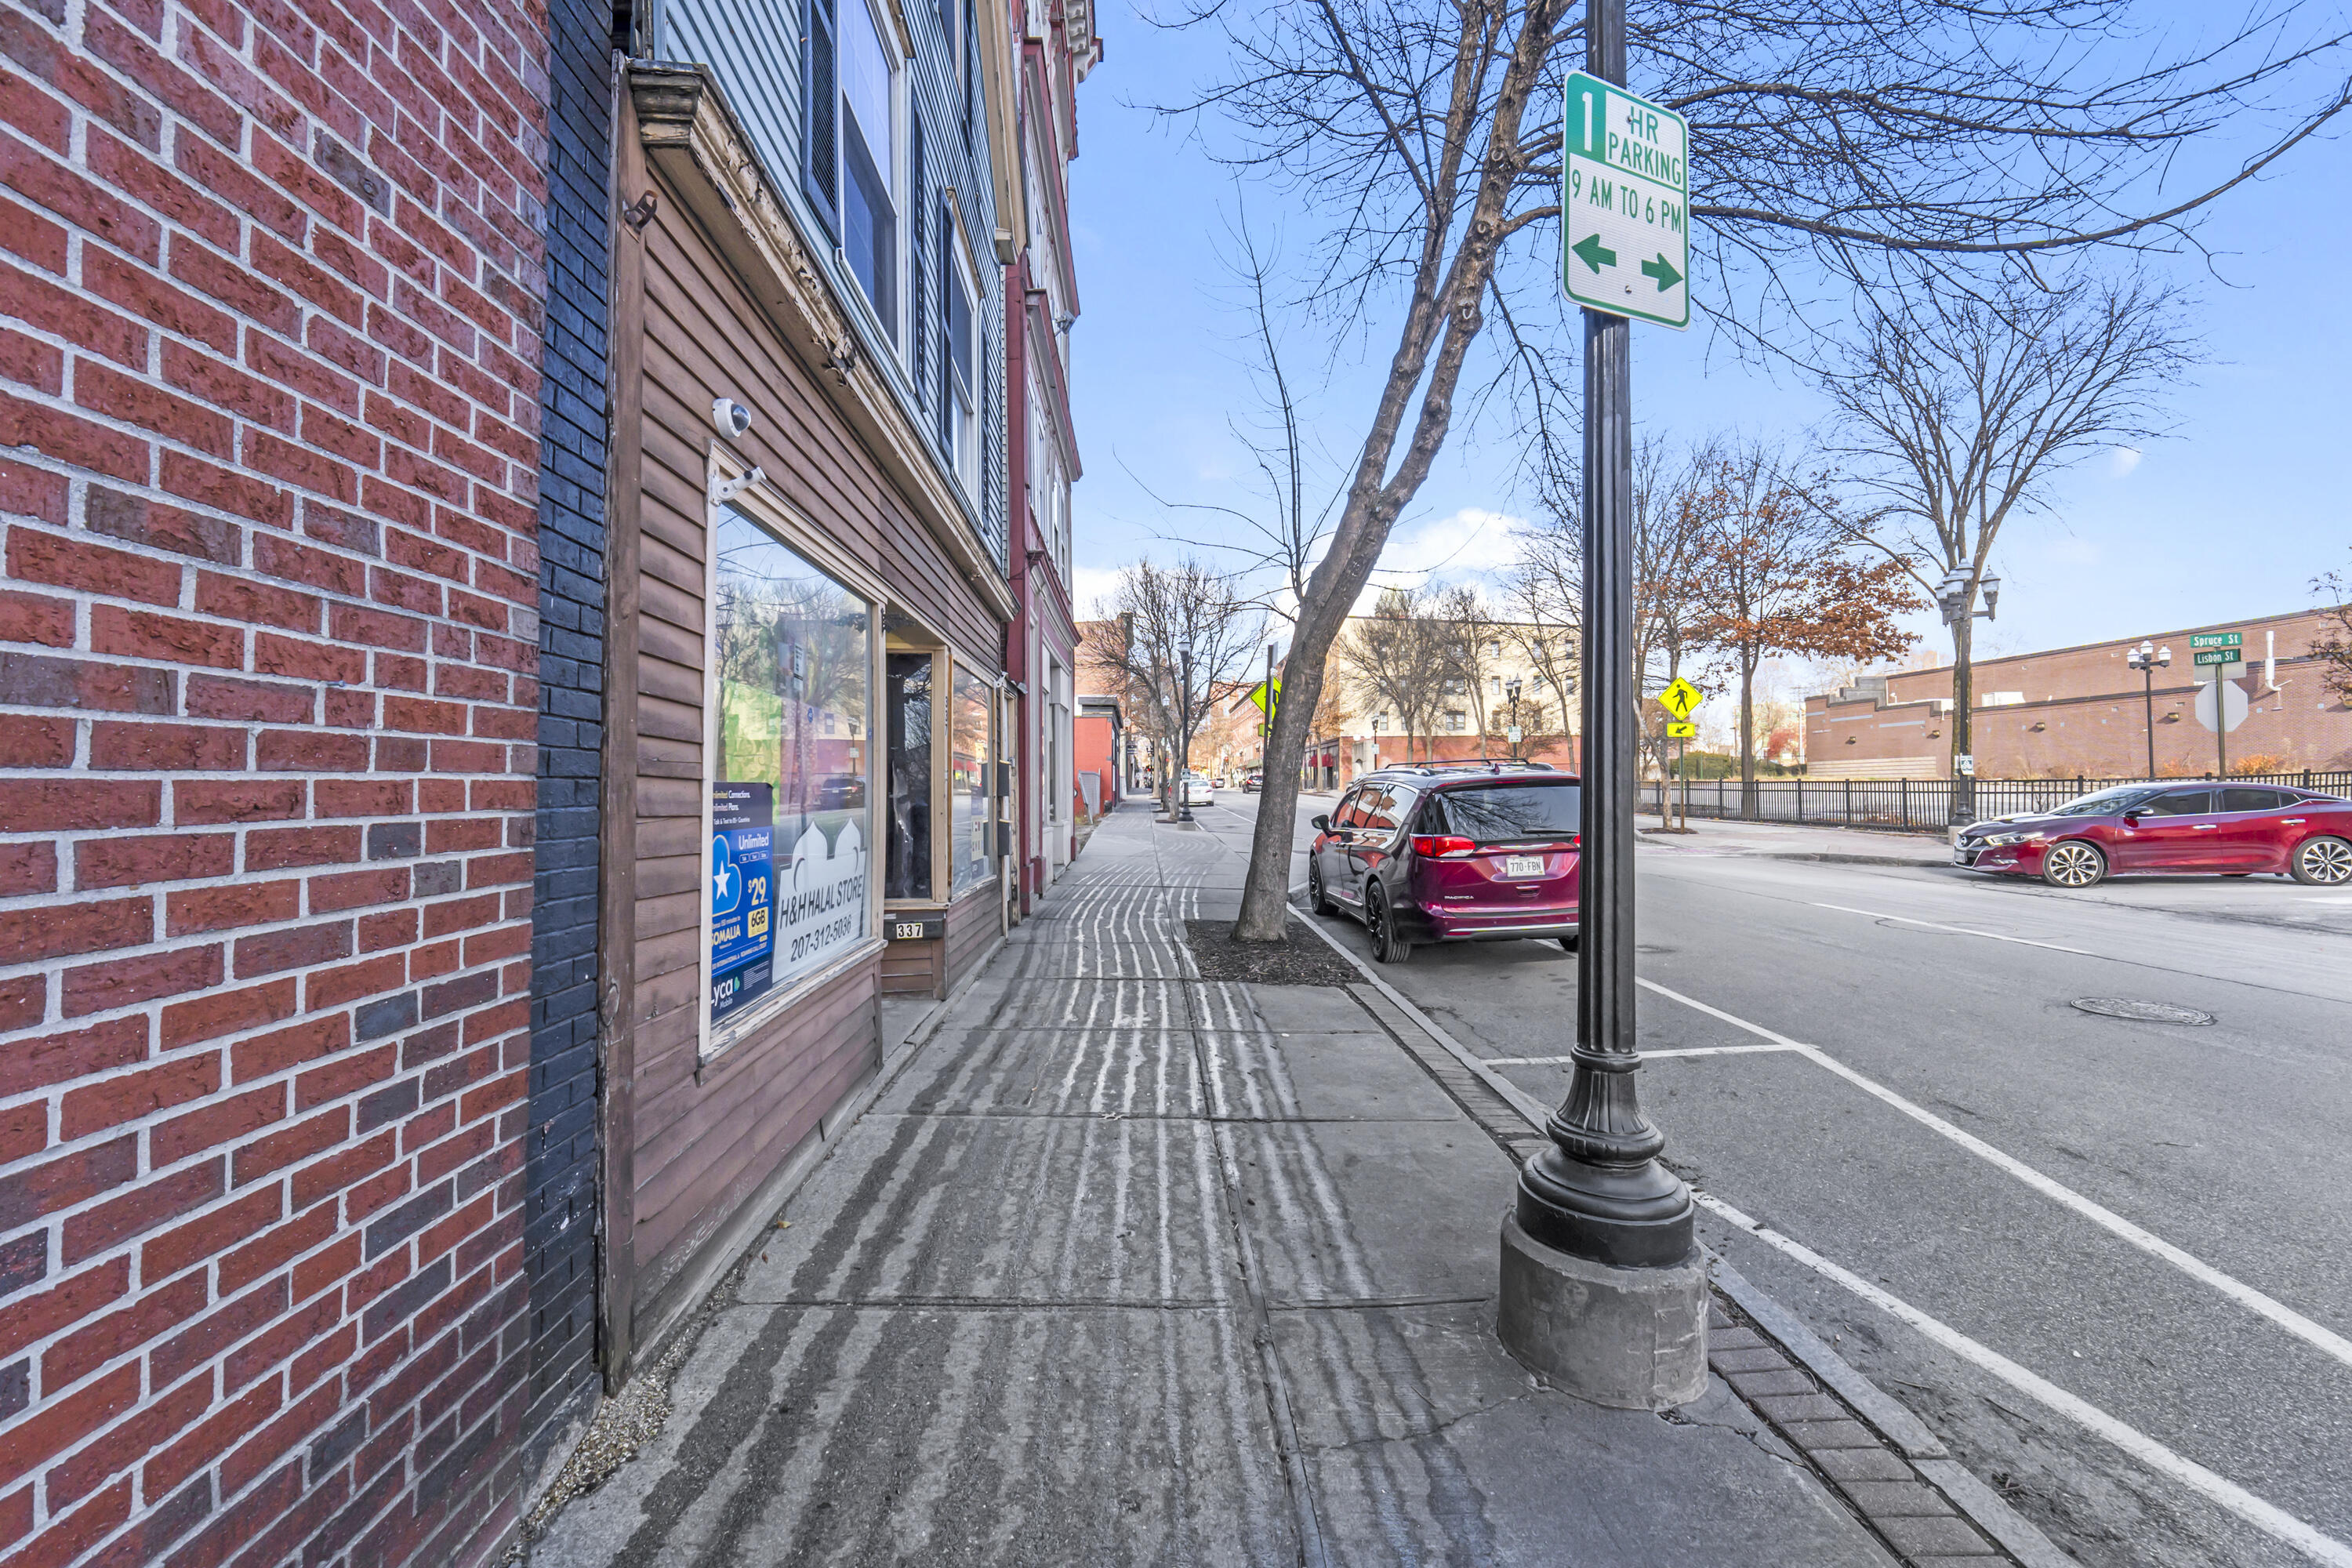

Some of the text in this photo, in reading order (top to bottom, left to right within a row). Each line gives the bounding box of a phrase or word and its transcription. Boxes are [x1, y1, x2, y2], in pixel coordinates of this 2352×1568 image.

[1582, 91, 1593, 152] 1
[1630, 105, 1658, 144] HR
[1609, 132, 1681, 185] PARKING
[1572, 169, 1682, 234] 9 AM TO 6 PM
[2194, 634, 2238, 647] Spruce St
[2198, 651, 2234, 664] Lisbon St
[739, 832, 769, 850] Unlimited
[748, 877, 766, 906] $29
[779, 874, 862, 929] H&H HALAL STORE
[751, 909, 765, 927] 6GB
[898, 924, 921, 937] 337
[790, 914, 851, 962] 207-312-5036
